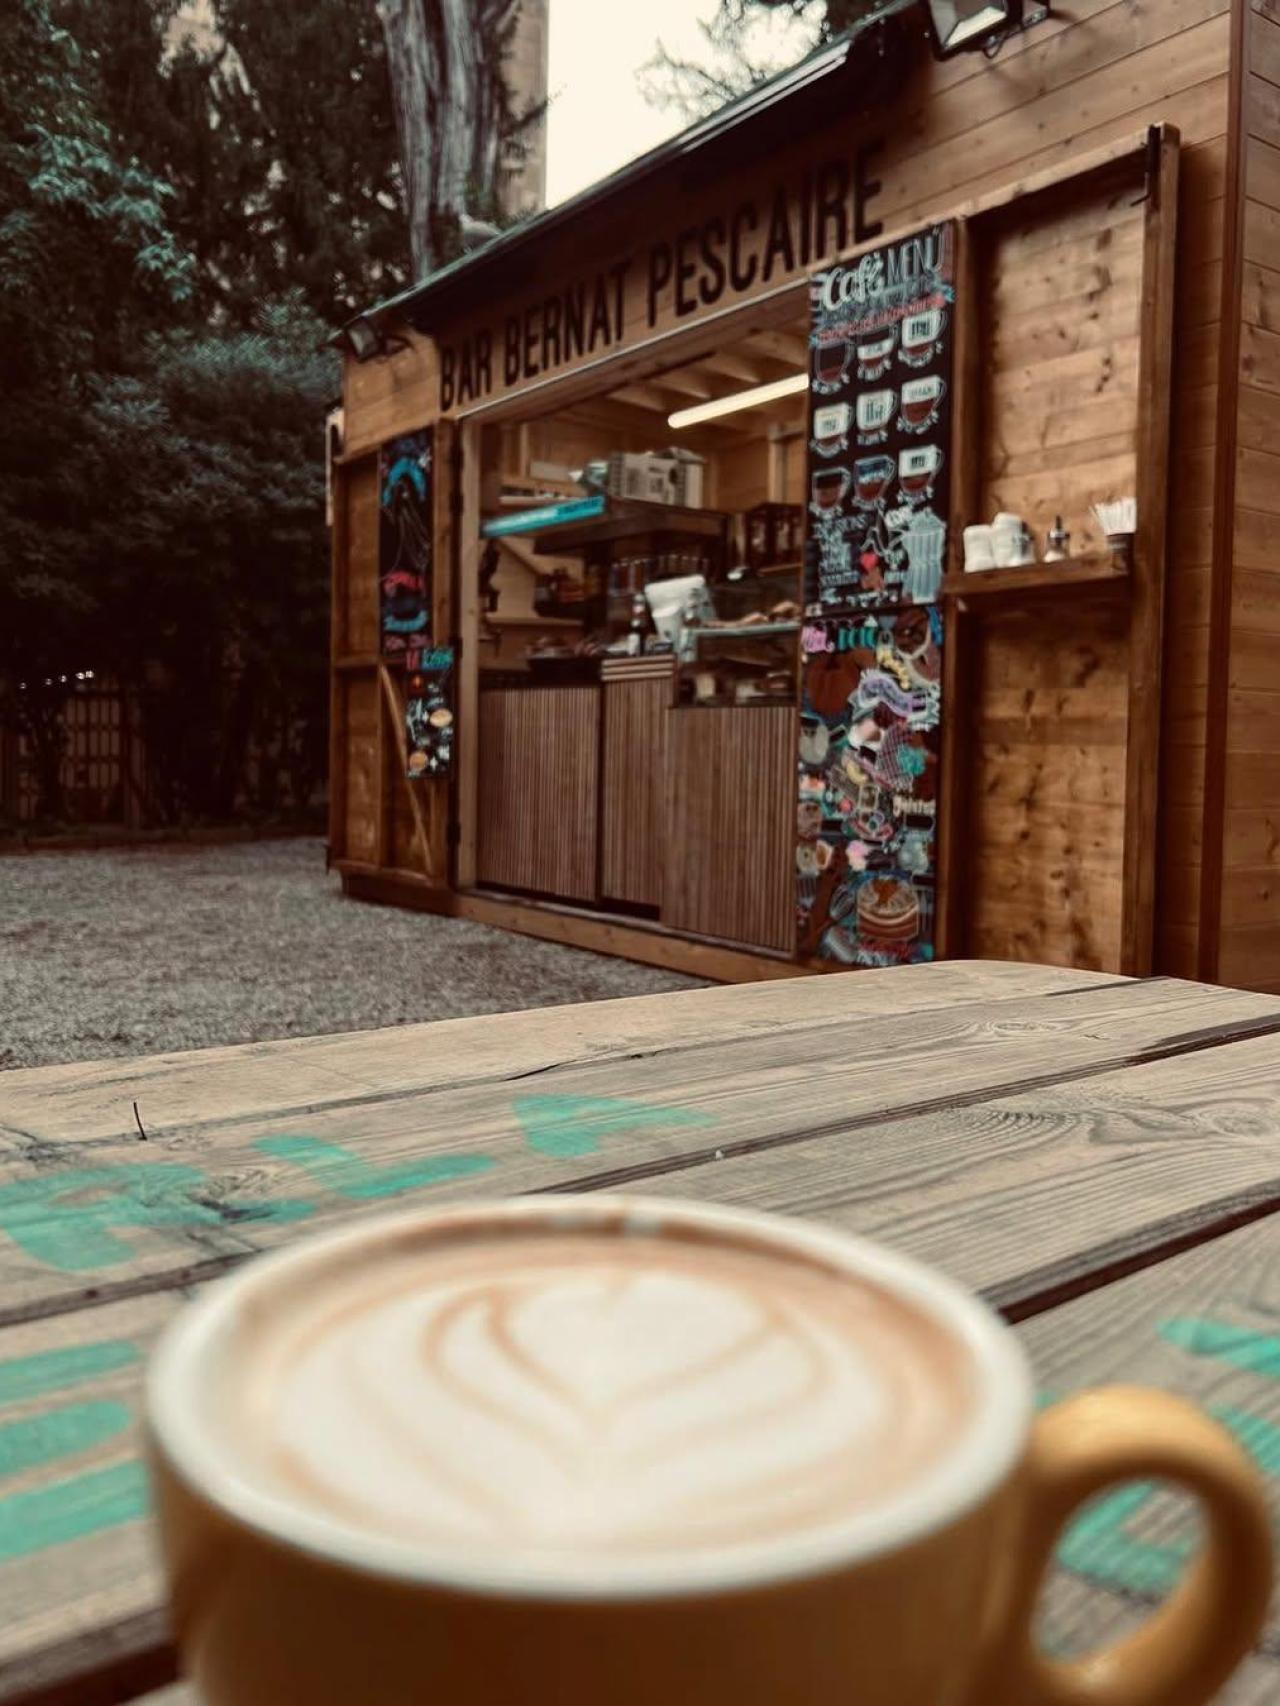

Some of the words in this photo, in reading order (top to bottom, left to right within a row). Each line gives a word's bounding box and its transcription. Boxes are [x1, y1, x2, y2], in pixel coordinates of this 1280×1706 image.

[440, 327, 493, 412] BAR
[503, 259, 632, 388] BERNAT
[646, 140, 884, 329] PESCAIRE
